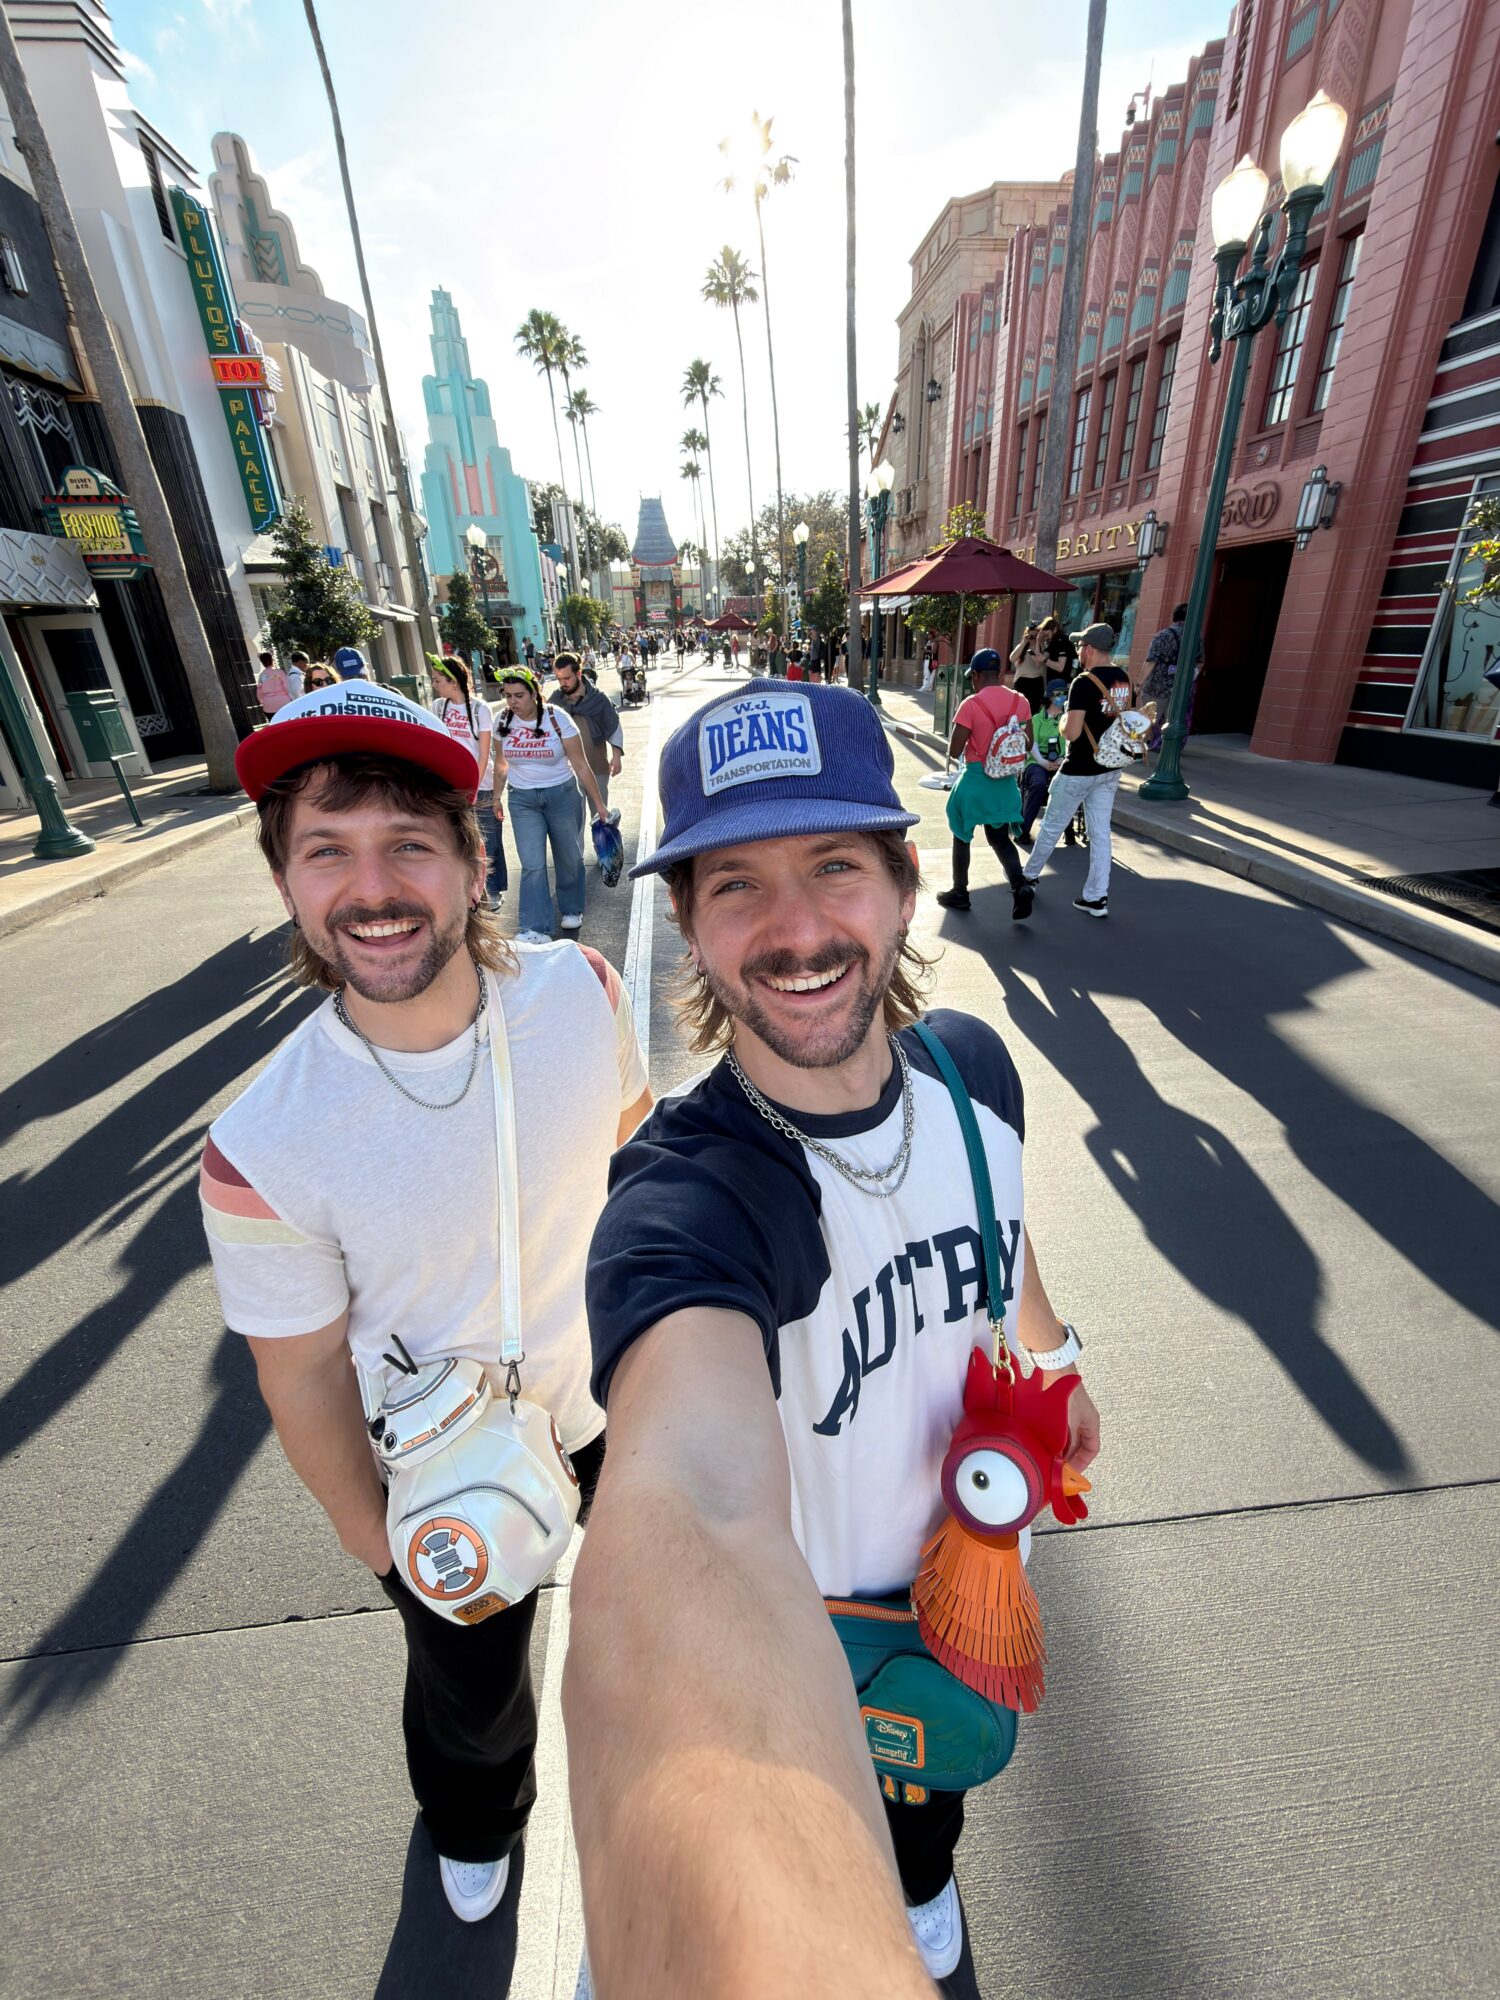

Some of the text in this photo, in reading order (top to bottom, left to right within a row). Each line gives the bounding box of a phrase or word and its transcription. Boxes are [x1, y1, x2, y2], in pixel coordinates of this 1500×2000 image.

[183, 212, 230, 347] PLUTO'S
[216, 361, 261, 380] TOY
[229, 400, 268, 513] PALACE
[350, 694, 398, 707] FLORIDA
[706, 705, 808, 776] DEANS
[708, 757, 812, 787] TRANSPORTATION
[875, 1720, 908, 1741] Disney
